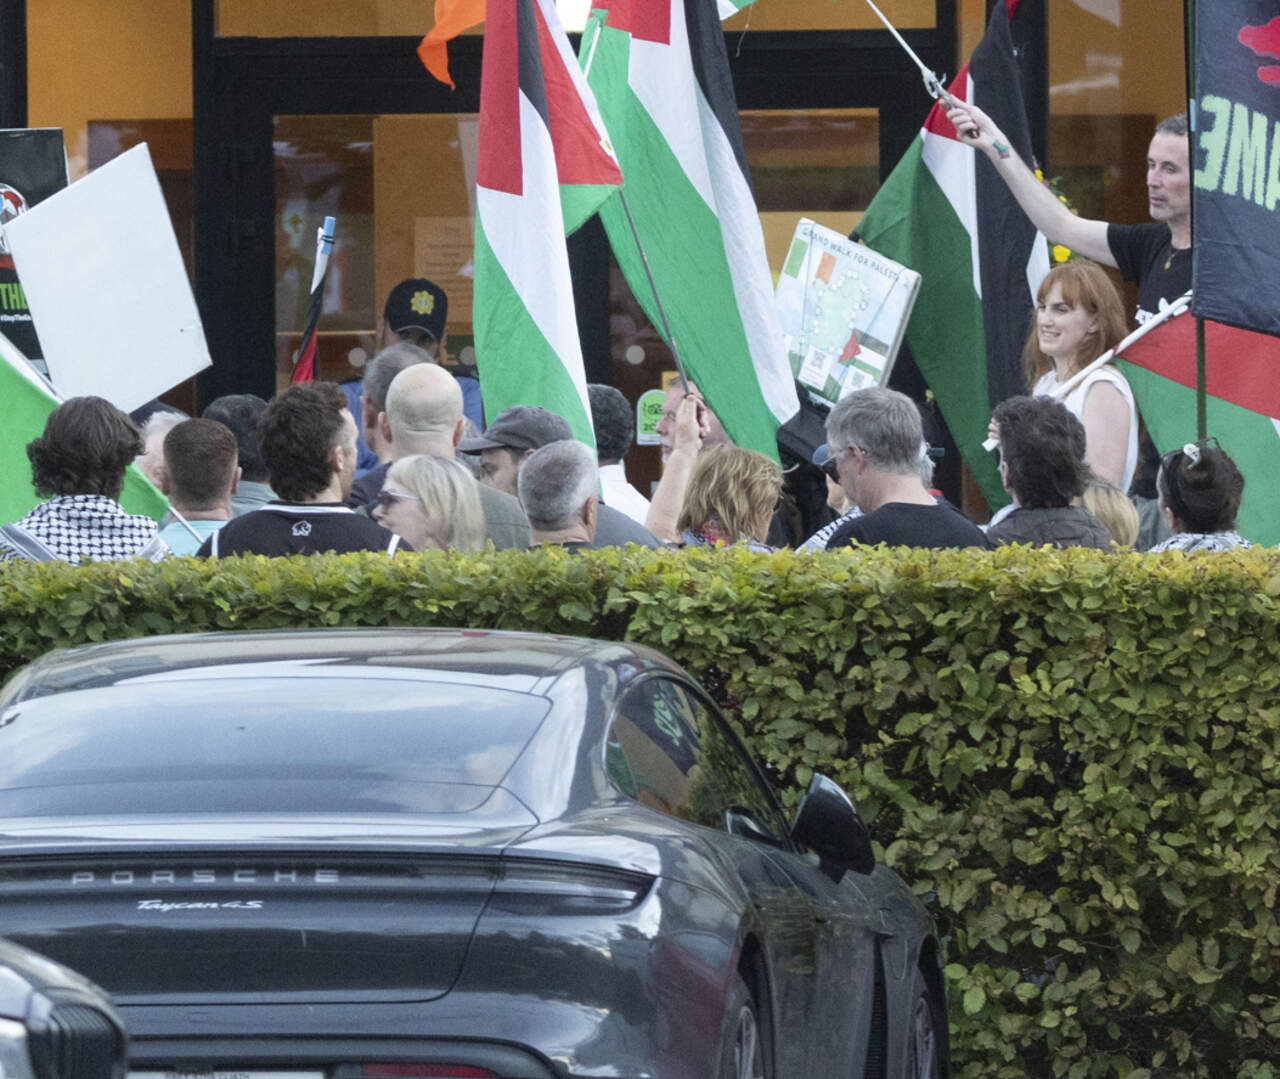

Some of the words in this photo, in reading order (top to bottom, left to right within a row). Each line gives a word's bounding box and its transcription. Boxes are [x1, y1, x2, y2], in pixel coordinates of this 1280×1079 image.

[831, 243, 852, 259] WALK
[853, 252, 870, 267] FOR
[72, 870, 339, 885] PORSCHE
[136, 899, 219, 912] Taycan
[220, 900, 264, 909] 4S
